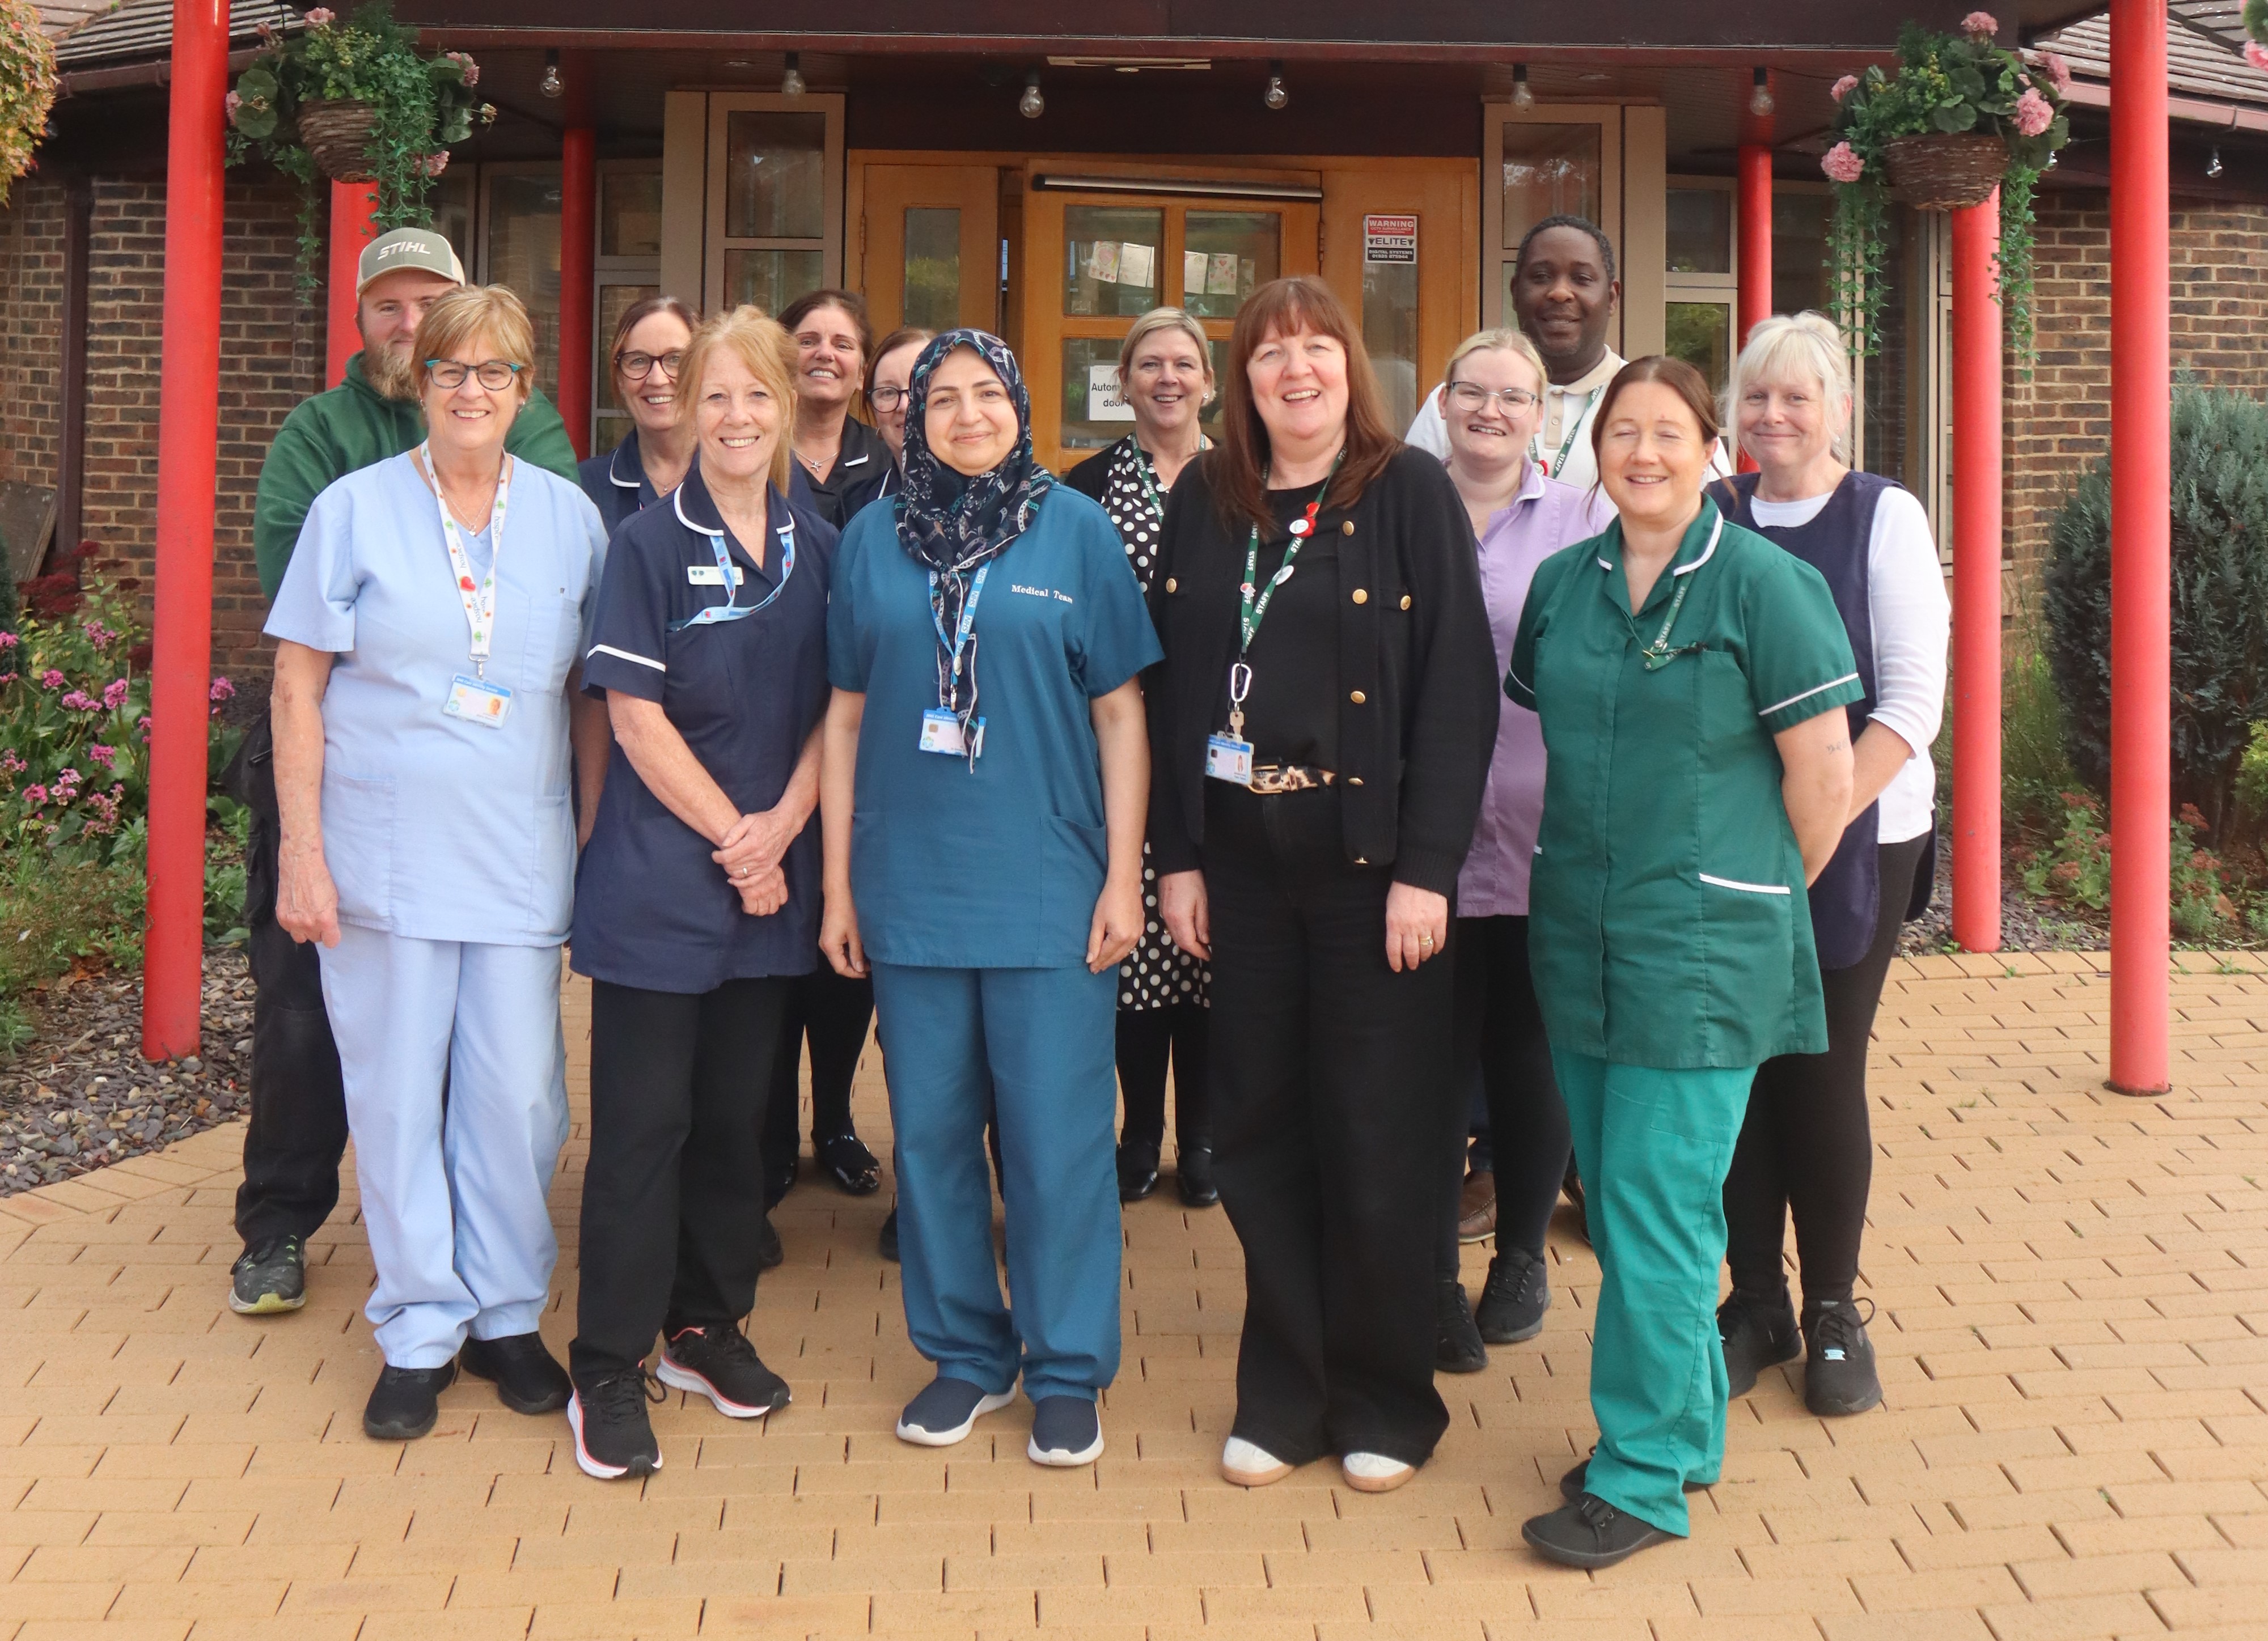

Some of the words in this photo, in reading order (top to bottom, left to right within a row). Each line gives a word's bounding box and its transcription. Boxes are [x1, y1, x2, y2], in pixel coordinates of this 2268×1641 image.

[378, 241, 430, 261] STIHL
[1136, 456, 1145, 472] STAFF
[1555, 453, 1566, 472] STAFF
[1144, 480, 1155, 495] STAFF
[1153, 502, 1164, 516] STAFF
[976, 568, 987, 583] NHS
[968, 591, 979, 607] NHS
[1011, 584, 1048, 597] Medical
[1053, 590, 1073, 604] Team
[1256, 591, 1270, 614] STAFF
[1673, 586, 1686, 608] STAFF
[471, 597, 483, 624] hospice
[962, 616, 972, 633] NHS
